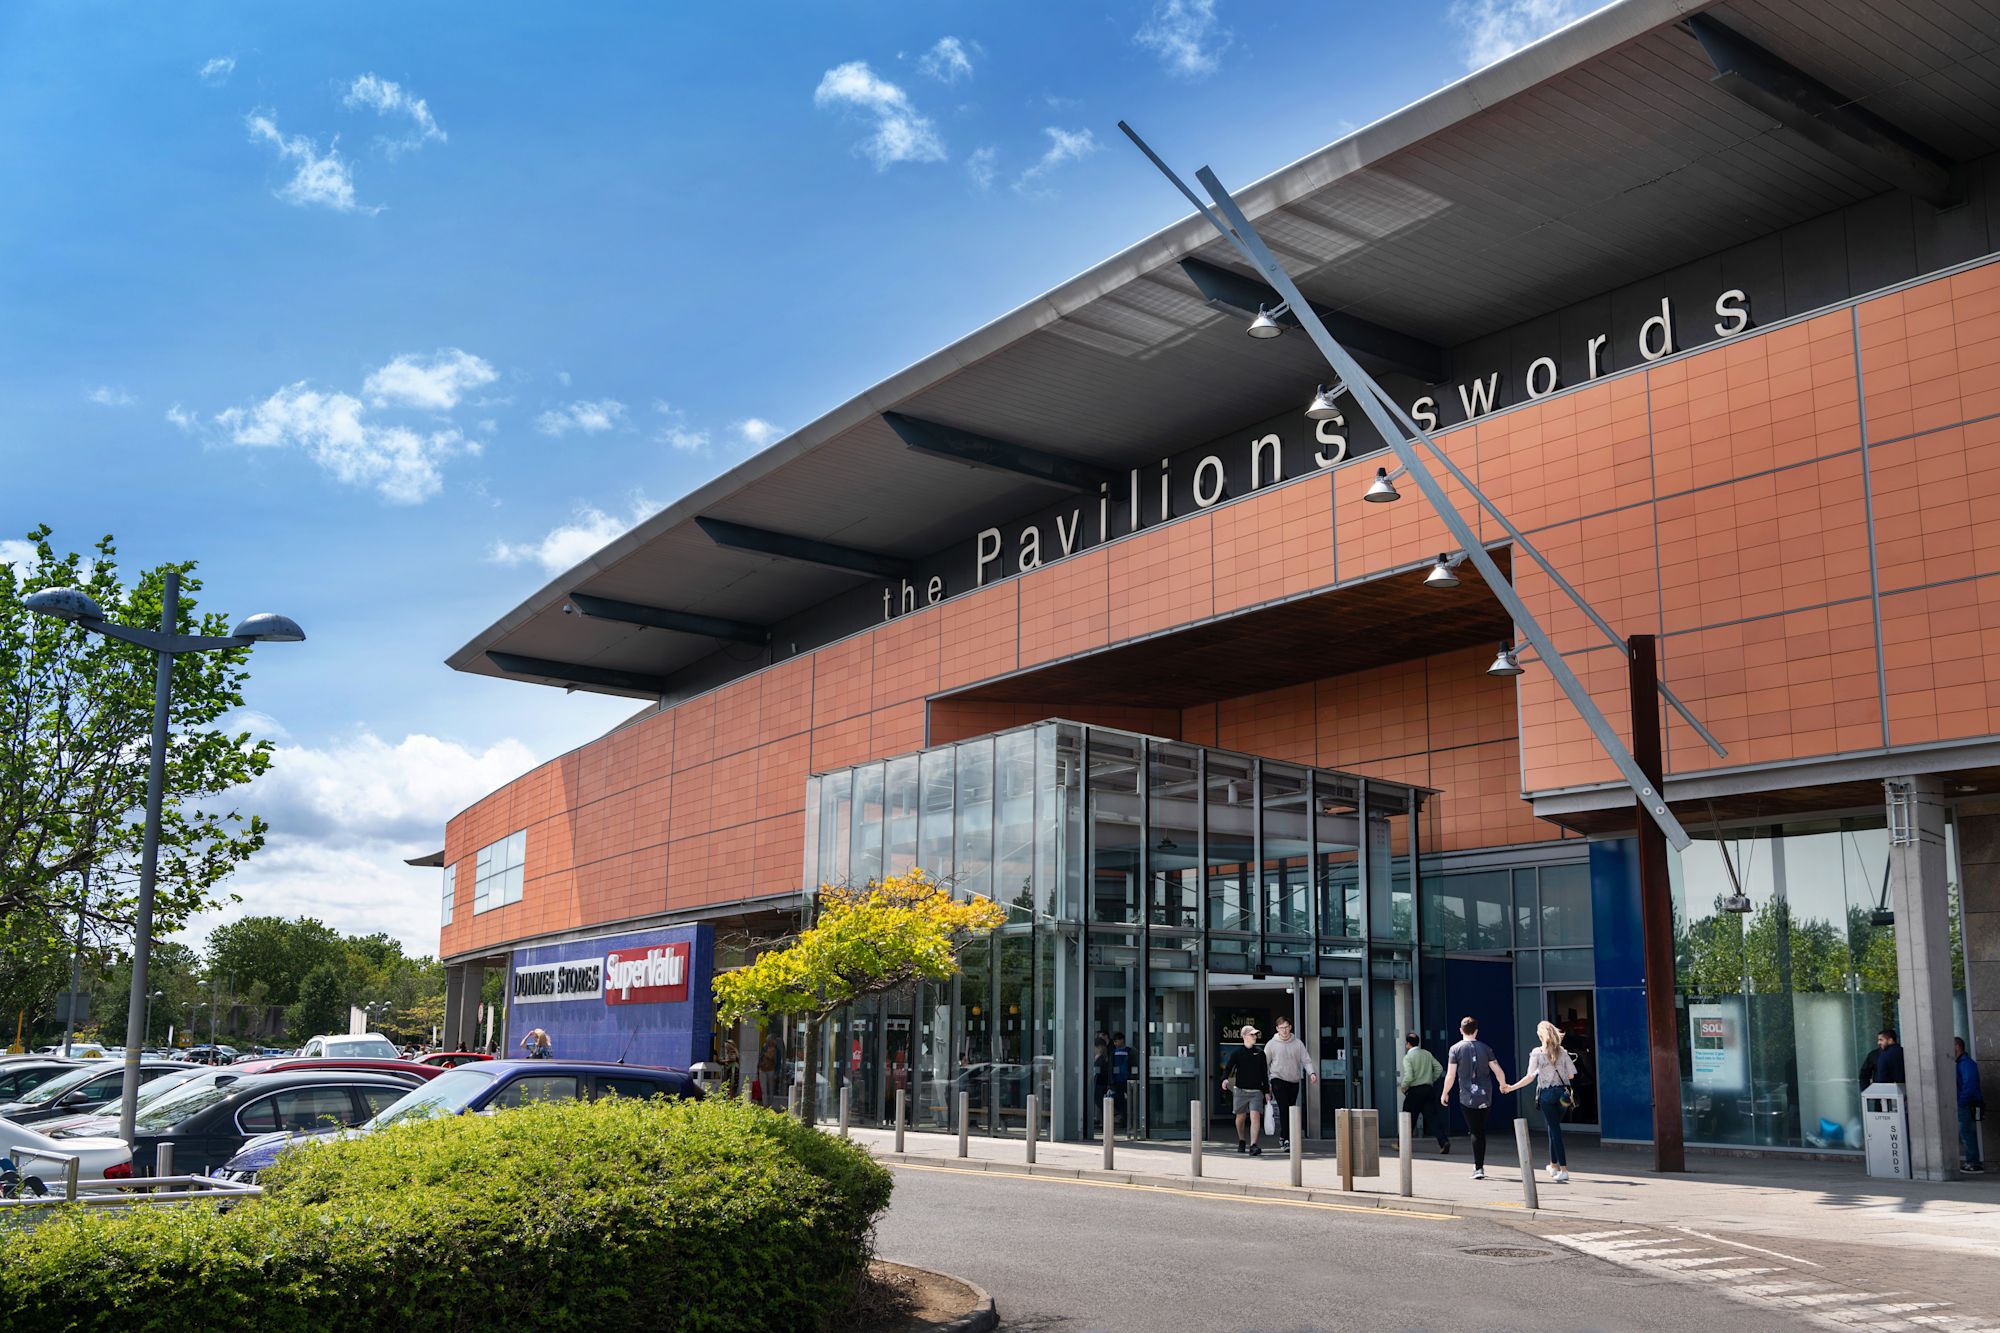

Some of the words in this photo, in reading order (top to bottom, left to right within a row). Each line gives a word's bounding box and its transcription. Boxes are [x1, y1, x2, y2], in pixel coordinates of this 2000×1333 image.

[883, 573, 943, 621] the
[976, 414, 1347, 586] Pavilions
[1411, 289, 1749, 433] swords
[515, 969, 555, 997] DUNNES
[557, 965, 600, 995] STORES
[605, 947, 685, 1001] SuperValu
[1890, 1125, 1900, 1174] SWORDS
